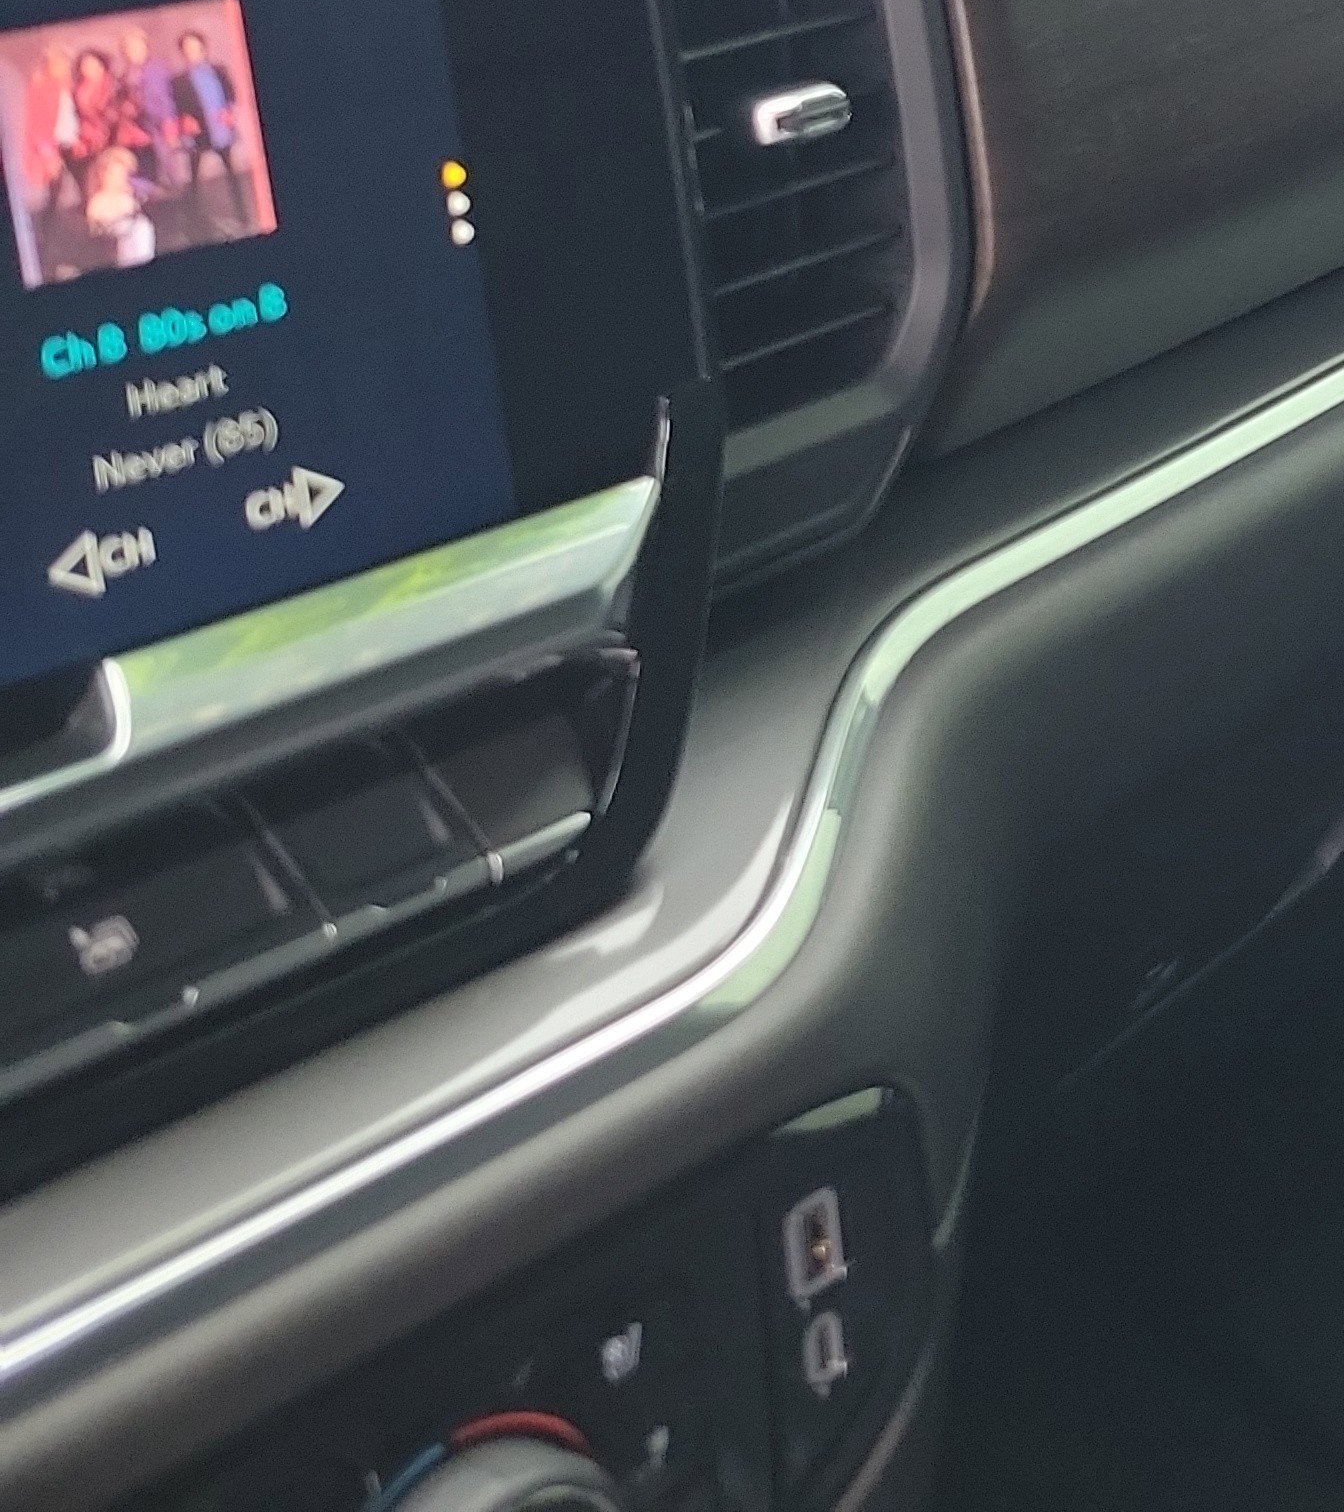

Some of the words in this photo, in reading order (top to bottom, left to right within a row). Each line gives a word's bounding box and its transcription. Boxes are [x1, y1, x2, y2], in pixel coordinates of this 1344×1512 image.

[41, 331, 97, 379] Ch
[208, 298, 259, 335] on
[125, 363, 230, 421] Heart
[92, 436, 200, 493] Never
[99, 526, 157, 579] CH
